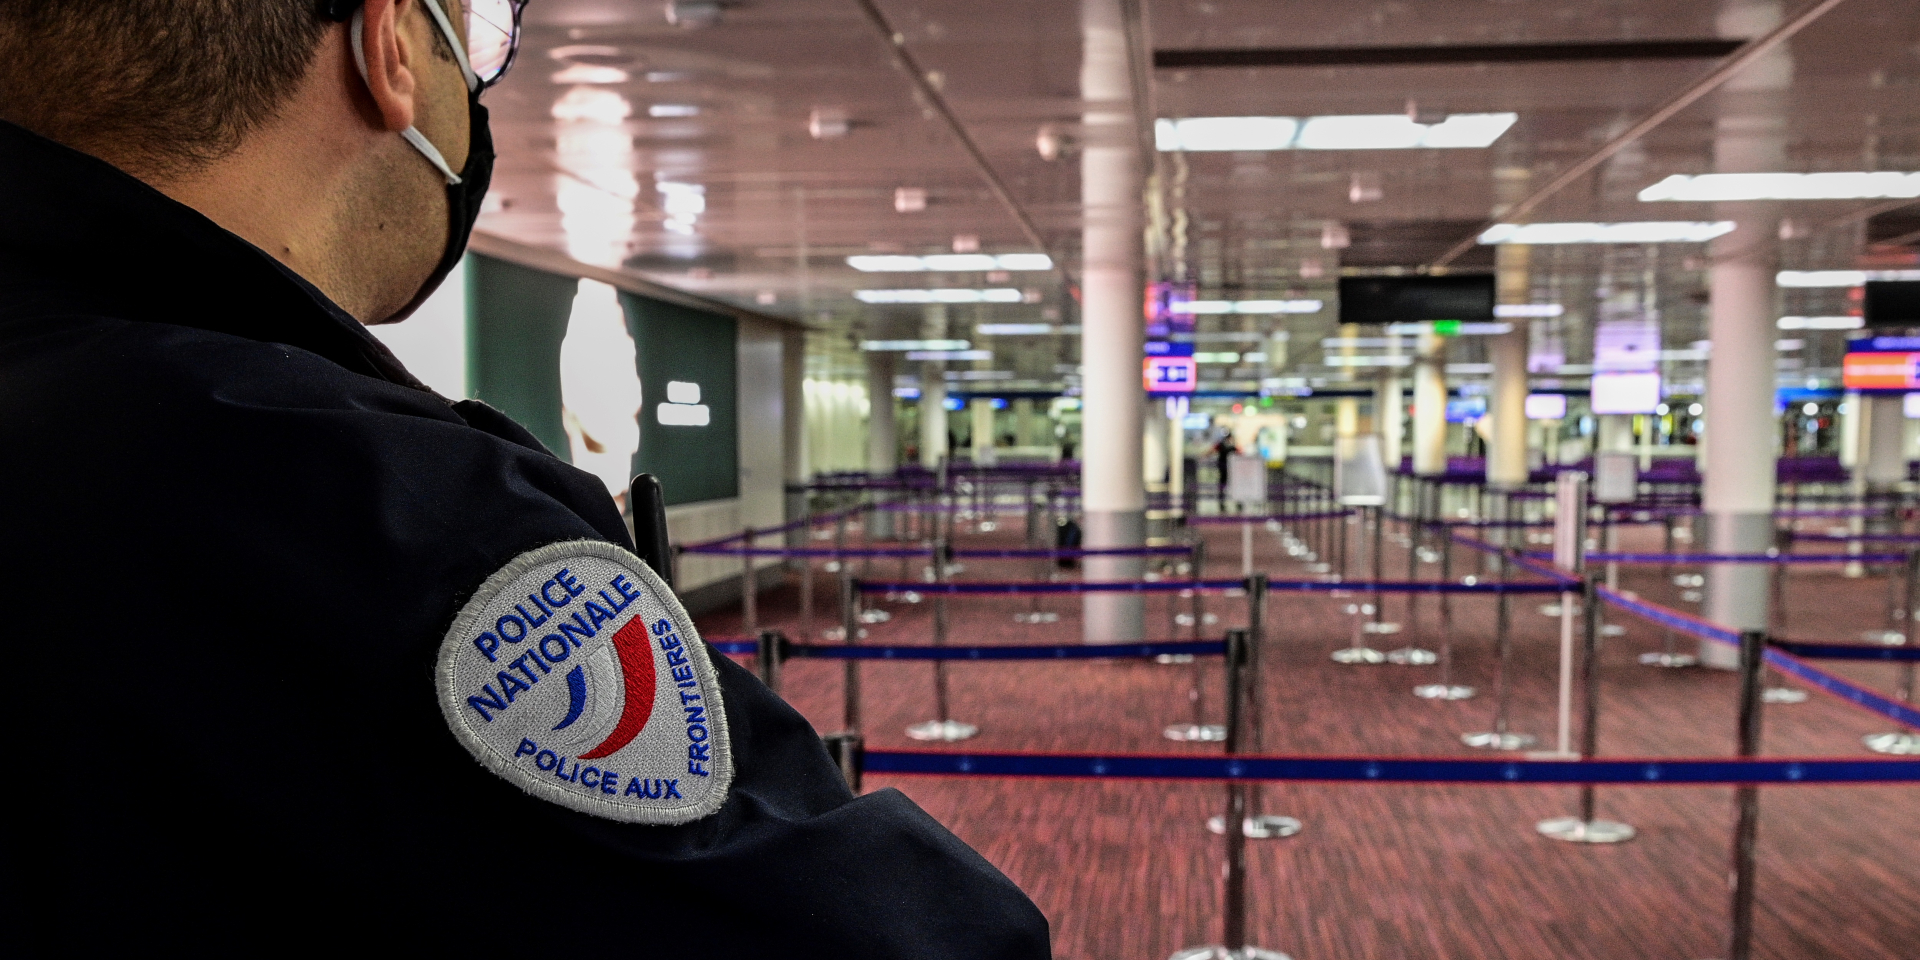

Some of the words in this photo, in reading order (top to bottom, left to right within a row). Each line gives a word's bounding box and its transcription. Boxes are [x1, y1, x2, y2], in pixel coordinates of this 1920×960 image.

[467, 574, 641, 722] NATIONALE
[473, 568, 586, 663] POLICE
[652, 618, 710, 777] FRONTIERES
[514, 737, 619, 795] POLICE
[625, 777, 683, 800] AUX
